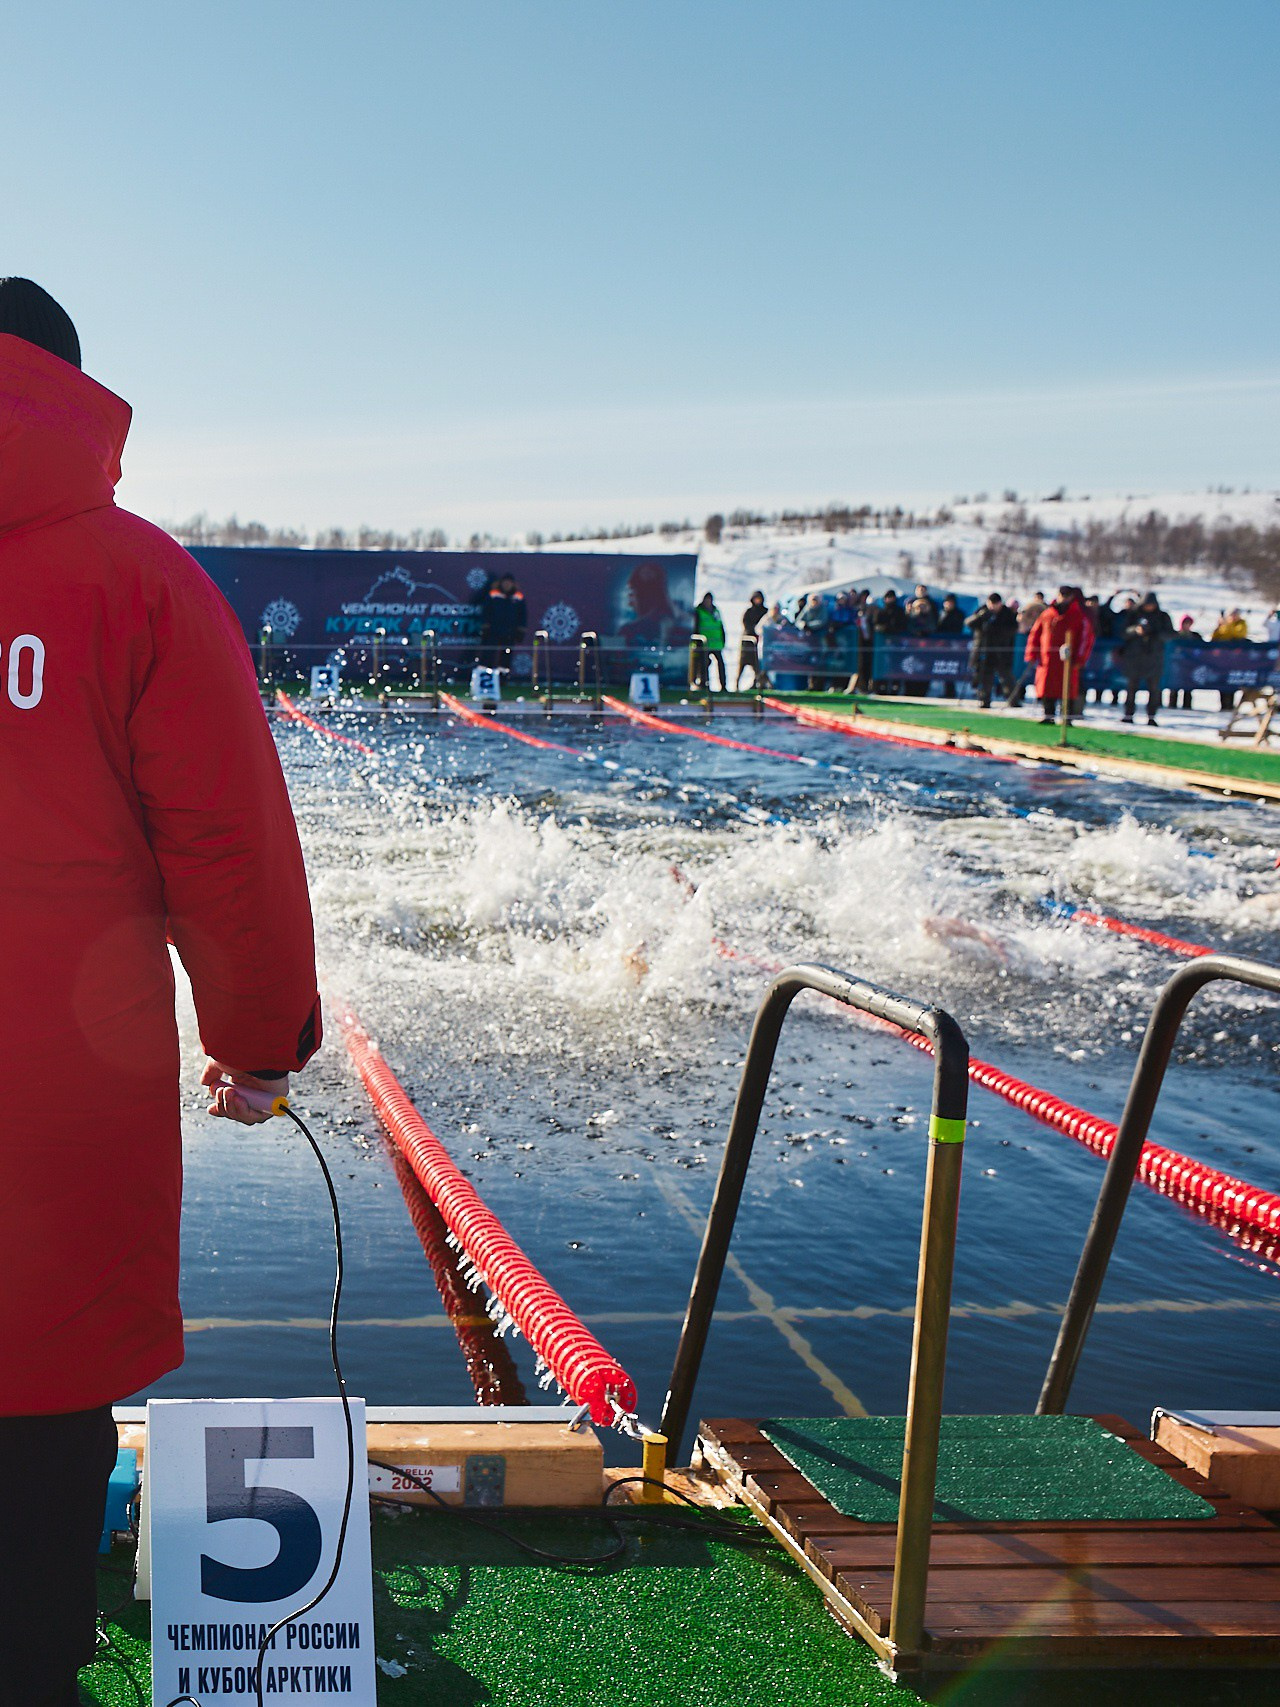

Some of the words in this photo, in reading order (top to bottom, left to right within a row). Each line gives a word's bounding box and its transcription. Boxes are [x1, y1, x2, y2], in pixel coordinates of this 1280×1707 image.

[479, 673, 493, 689] 2
[641, 677, 653, 694] 1
[392, 1476, 433, 1490] 2022
[200, 1426, 322, 1603] 5
[167, 1623, 276, 1650] ЧЕМПИОНАТ
[286, 1622, 360, 1650] РОССИИ
[178, 1667, 191, 1694] И
[198, 1667, 260, 1694] КУБОК
[266, 1665, 352, 1693] АРКТИКИ
